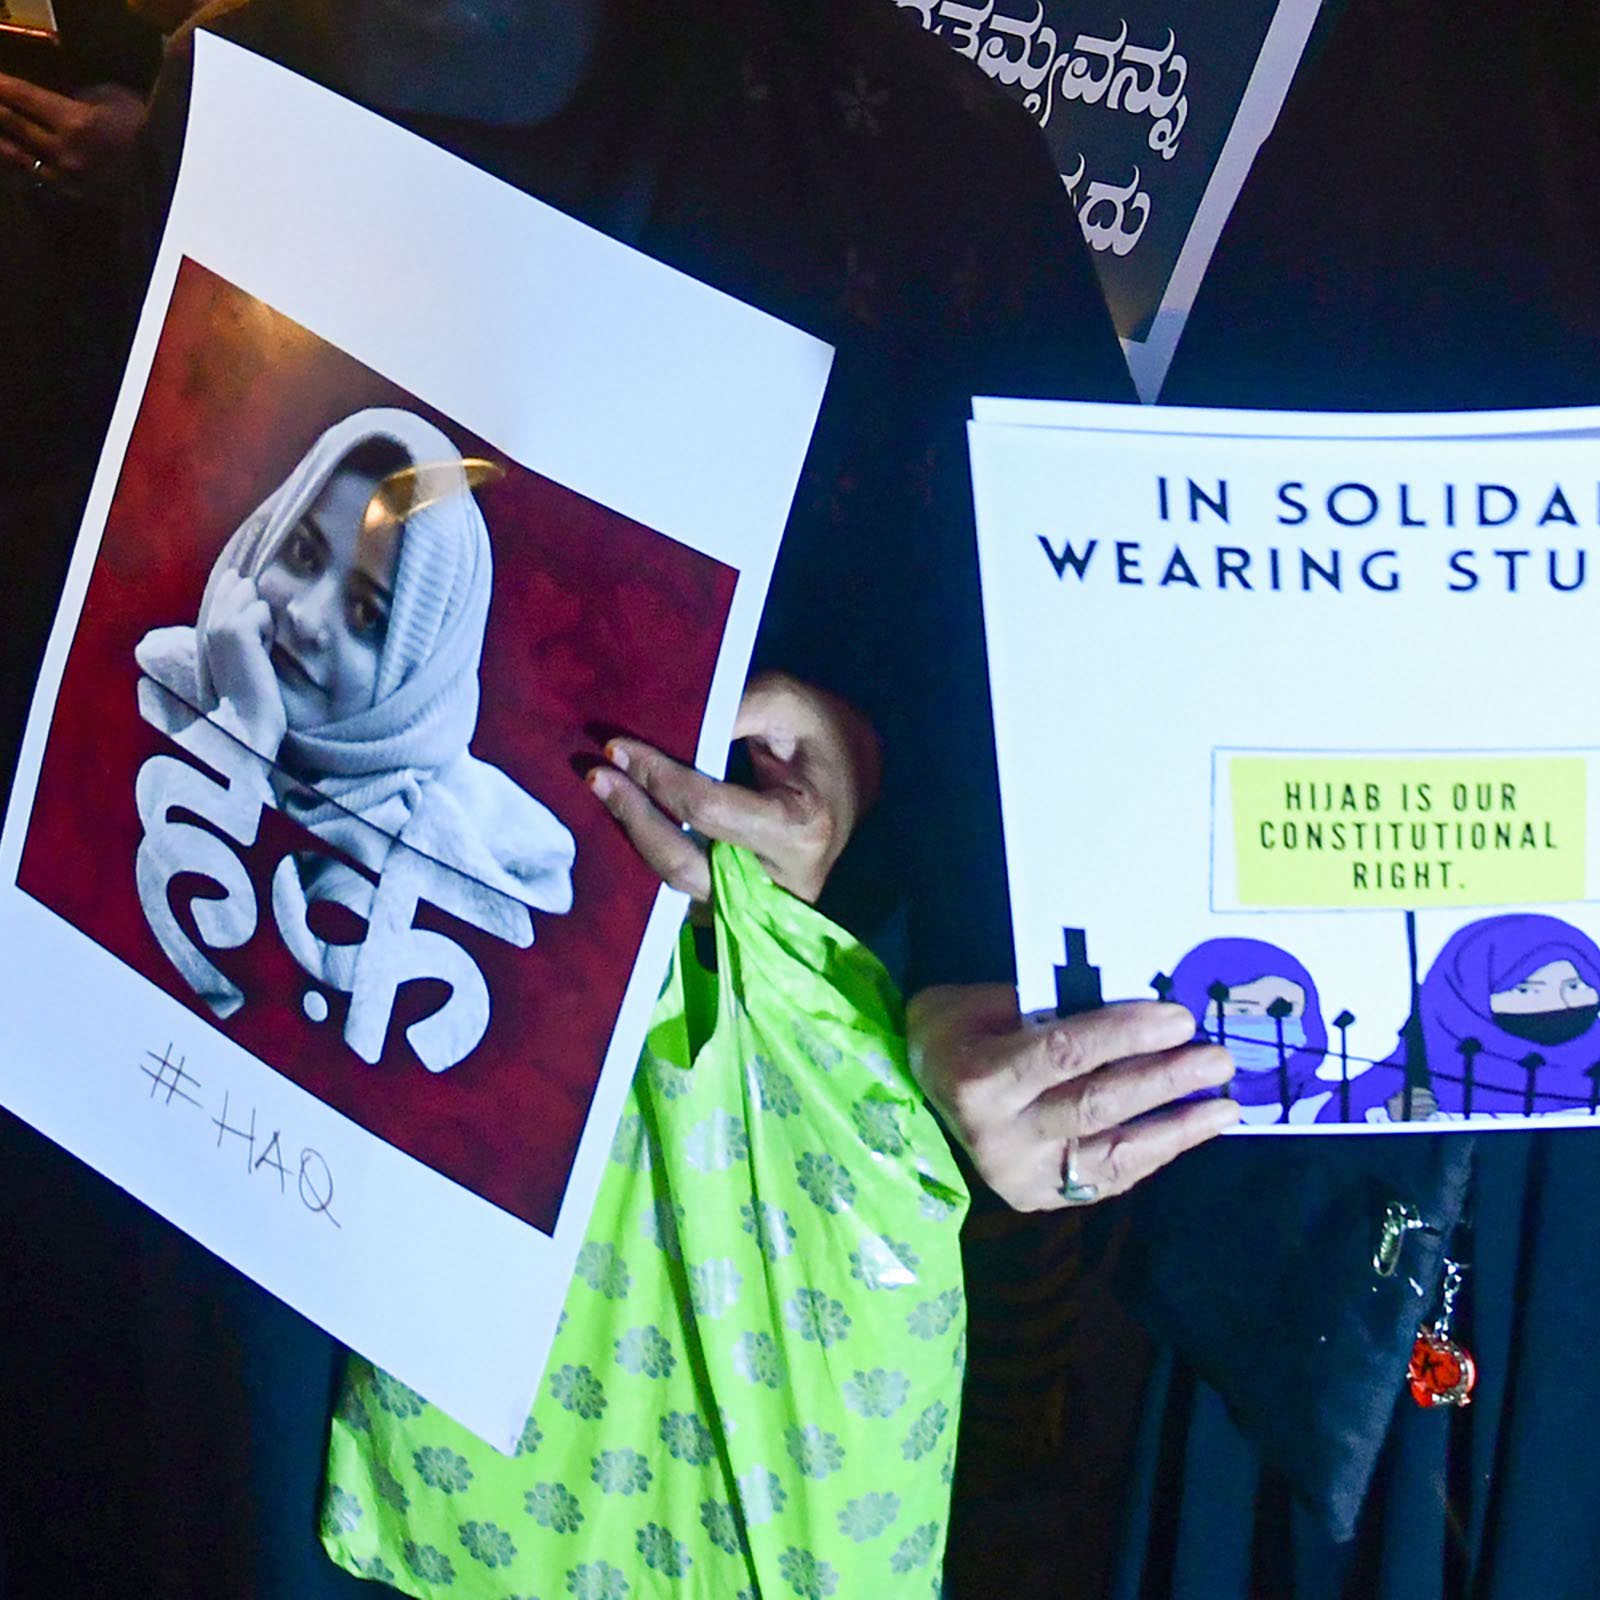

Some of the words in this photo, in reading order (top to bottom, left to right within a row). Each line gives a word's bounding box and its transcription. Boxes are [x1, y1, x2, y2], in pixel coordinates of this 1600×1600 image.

[1156, 476, 1231, 526] IN
[1035, 534, 1403, 594] WEARING
[1285, 781, 1382, 813] HIJAB
[1402, 782, 1433, 812] IS
[1453, 782, 1519, 812] OUR
[1260, 820, 1559, 852] CONSTITUTIONAL
[1352, 860, 1467, 891] RIGHT.
